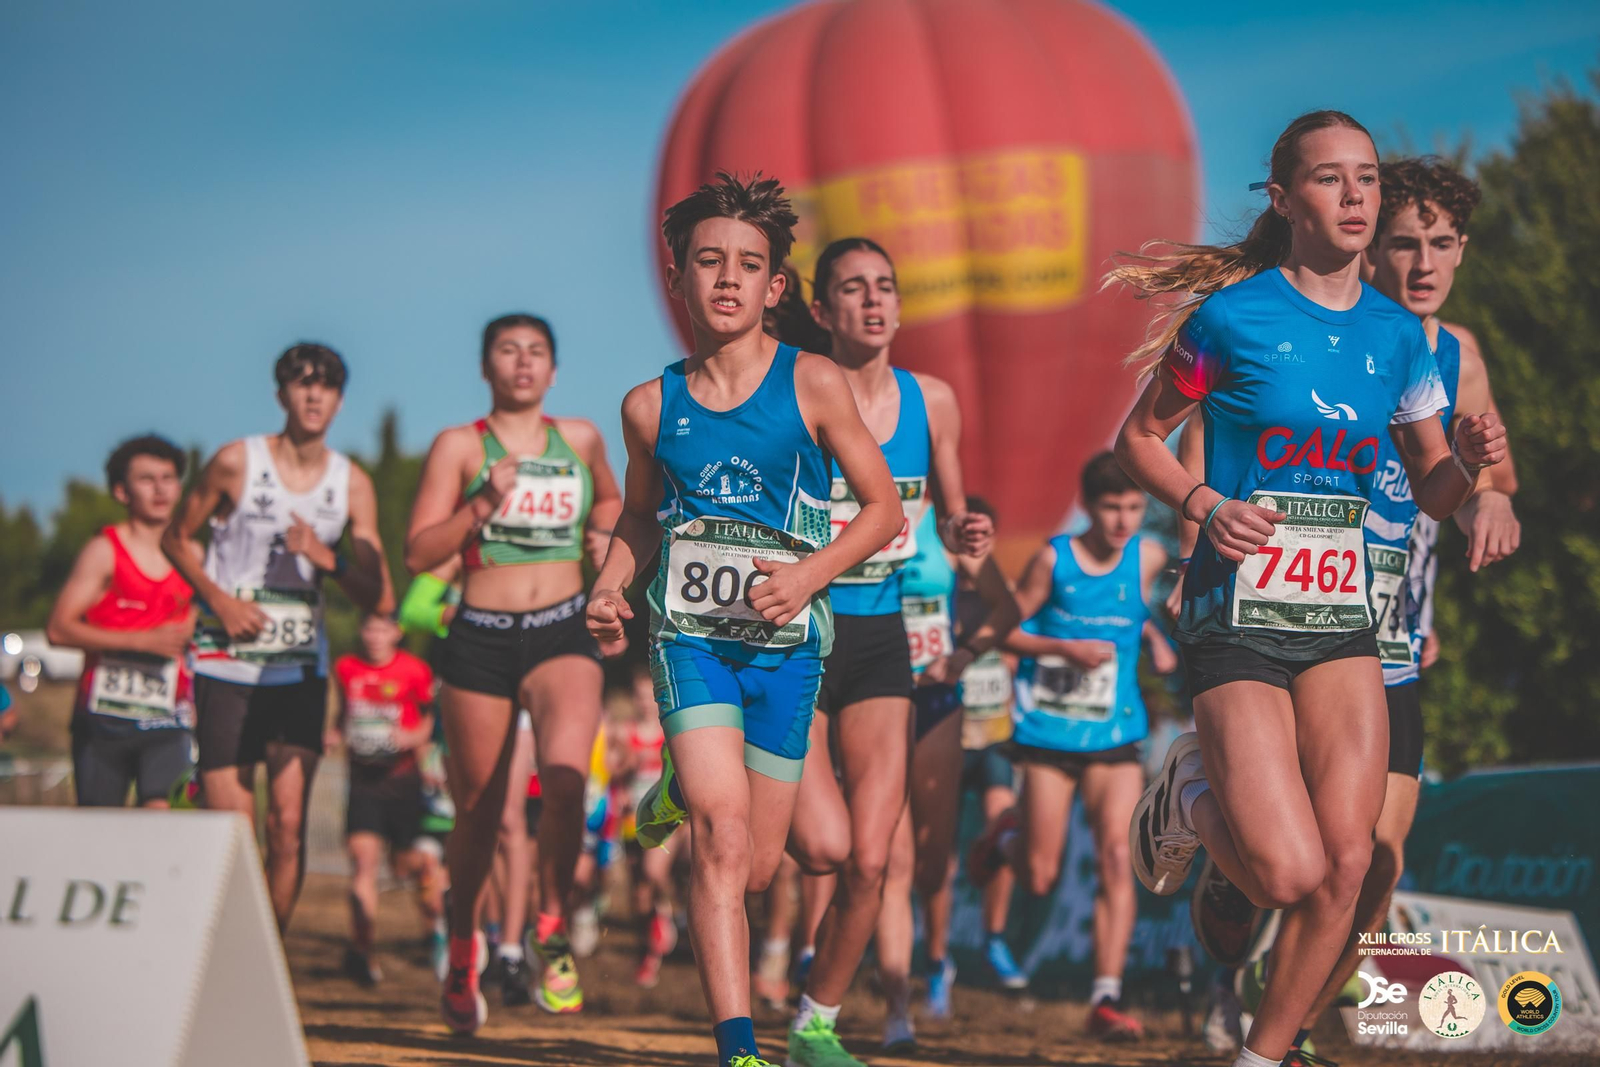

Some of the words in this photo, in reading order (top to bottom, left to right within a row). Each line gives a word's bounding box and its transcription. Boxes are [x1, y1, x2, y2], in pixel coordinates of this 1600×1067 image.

[1264, 353, 1306, 363] SPIRAL
[1256, 426, 1379, 475] GALO
[730, 456, 763, 492] ORIPPO
[1293, 473, 1340, 487] SPORT
[695, 488, 715, 497] DOS
[1286, 498, 1345, 518] ITÁLICA
[1255, 545, 1358, 594] 7462
[521, 600, 575, 630] NIKE
[56, 878, 146, 932] DE
